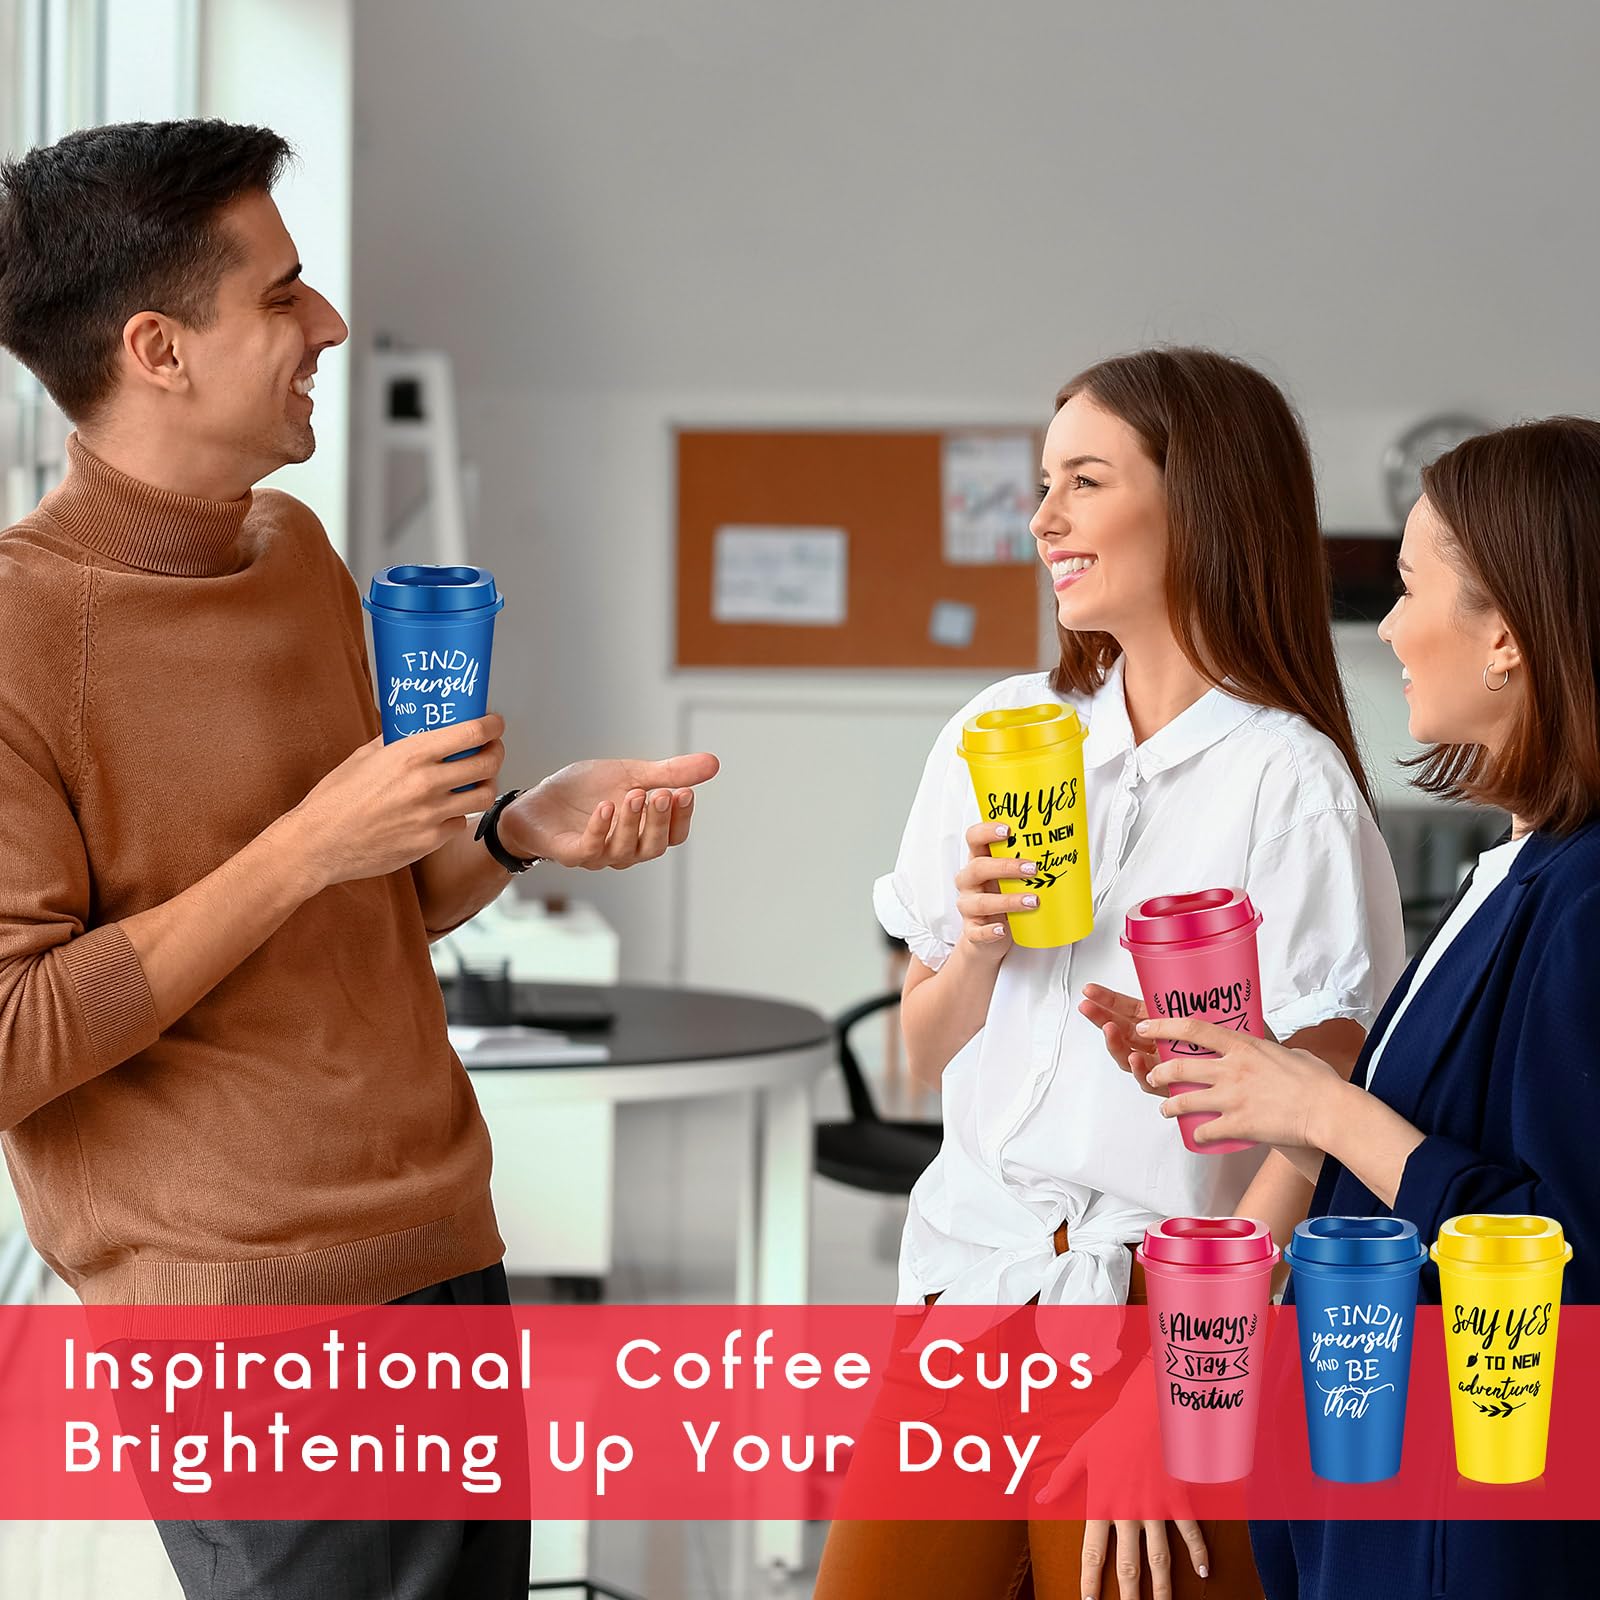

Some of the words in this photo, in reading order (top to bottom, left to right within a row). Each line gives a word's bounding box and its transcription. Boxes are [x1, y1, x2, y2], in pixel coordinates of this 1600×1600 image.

[402, 649, 467, 672] FIND
[388, 657, 480, 707] yourself
[395, 703, 417, 716] AND
[423, 703, 456, 726] BE
[987, 791, 1032, 830] SAY
[1037, 777, 1078, 826] YES
[1022, 832, 1043, 847] TO
[1048, 823, 1075, 844] NEW
[1323, 1303, 1391, 1328] FIND
[1452, 1304, 1500, 1350] SAY
[1505, 1302, 1552, 1351] YES
[1309, 1312, 1403, 1363] yourself
[1316, 1358, 1339, 1372] AND
[1344, 1358, 1380, 1382] BE
[1484, 1355, 1505, 1371] TO
[1512, 1351, 1541, 1370] NEW
[1170, 1381, 1244, 1411] Positive
[1457, 1373, 1541, 1400] adventures
[1323, 1384, 1370, 1419] that
